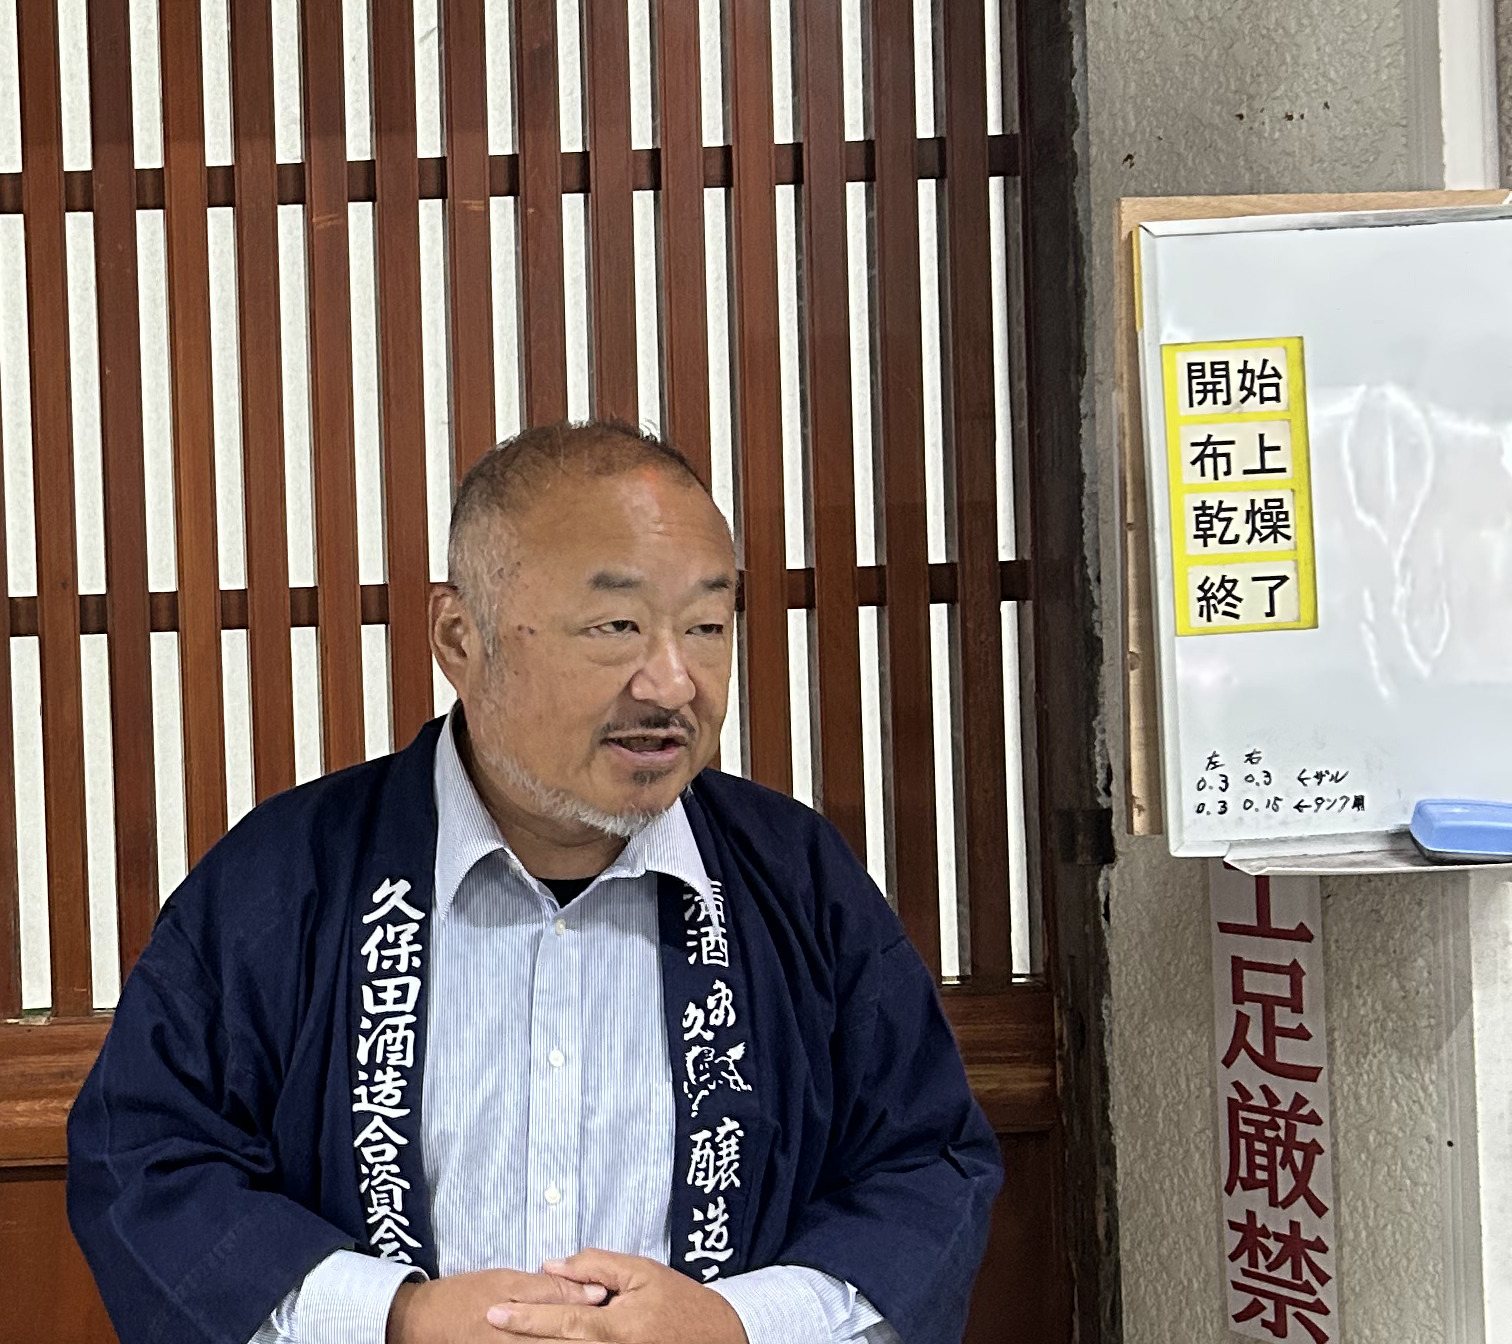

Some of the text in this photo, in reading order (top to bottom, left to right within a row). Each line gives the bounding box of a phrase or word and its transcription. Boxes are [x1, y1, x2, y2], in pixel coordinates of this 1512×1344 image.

[1187, 359, 1284, 408] 開始
[1190, 432, 1288, 481] 布上
[1193, 497, 1292, 548] 乾燥
[1196, 573, 1291, 623] 終了
[1196, 774, 1229, 792] 0.3
[1244, 770, 1272, 786] 0.3
[1205, 749, 1262, 771] 左 右
[1195, 800, 1228, 815] 0.3
[684, 1116, 745, 1282] 醸造
